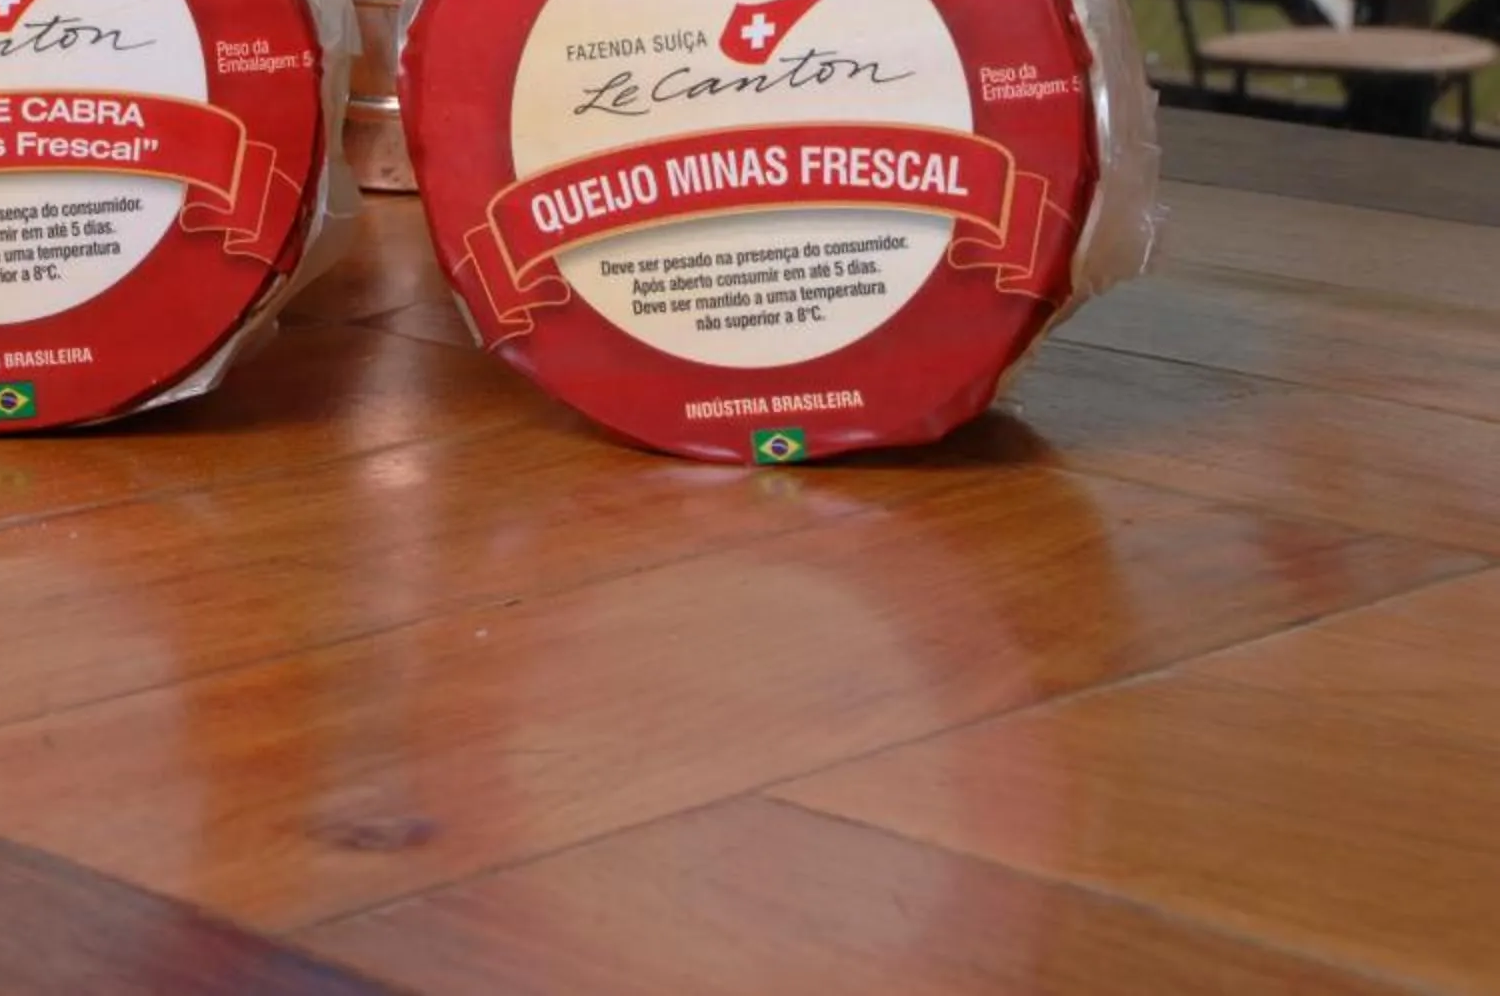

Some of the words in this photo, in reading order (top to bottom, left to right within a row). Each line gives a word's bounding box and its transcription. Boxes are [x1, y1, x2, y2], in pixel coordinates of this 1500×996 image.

[216, 41, 249, 57] Peso
[252, 39, 269, 54] da
[566, 36, 646, 62] FAZENDA
[653, 28, 707, 55] SUÍÇA
[218, 54, 299, 73] Embalagem:
[980, 67, 1016, 83] Peso
[1020, 64, 1036, 79] da
[573, 70, 650, 117] Le
[650, 47, 916, 103] Canton
[983, 79, 1069, 101] Embalagem:
[21, 96, 144, 128] CABRA
[531, 164, 658, 236] QUEIJO
[664, 145, 788, 197] MINAS
[801, 146, 970, 197] FRESCAL
[42, 203, 59, 218] do
[61, 198, 144, 217] consumidor.
[21, 226, 44, 240] em
[47, 222, 69, 238] até
[71, 222, 80, 236] 5
[83, 219, 116, 235] dias.
[4, 249, 35, 263] uma
[37, 240, 121, 262] temperatura
[601, 260, 635, 276] Deve
[638, 259, 660, 272] ser
[663, 253, 713, 273] pesado
[715, 253, 733, 266] na
[736, 248, 799, 267] presença
[802, 244, 821, 258] do
[823, 235, 909, 255] consumidor.
[21, 269, 31, 281] a
[632, 279, 666, 296] Após
[669, 276, 713, 291] aberto
[716, 270, 780, 287] consumir
[783, 268, 806, 281] em
[809, 264, 831, 279] até
[833, 262, 843, 277] 5
[847, 260, 881, 276] dias.
[632, 300, 667, 316] Deve
[670, 298, 692, 312] ser
[695, 292, 751, 310] mantido
[754, 294, 763, 305] a
[766, 290, 797, 304] uma
[800, 281, 885, 303] temperatura
[696, 316, 722, 331] não
[725, 309, 780, 329] superior
[784, 311, 794, 324] a
[4, 347, 93, 369] BRASILEIRA
[685, 396, 769, 420] INDÚSTRIA
[771, 390, 864, 413] BRASILEIRA
